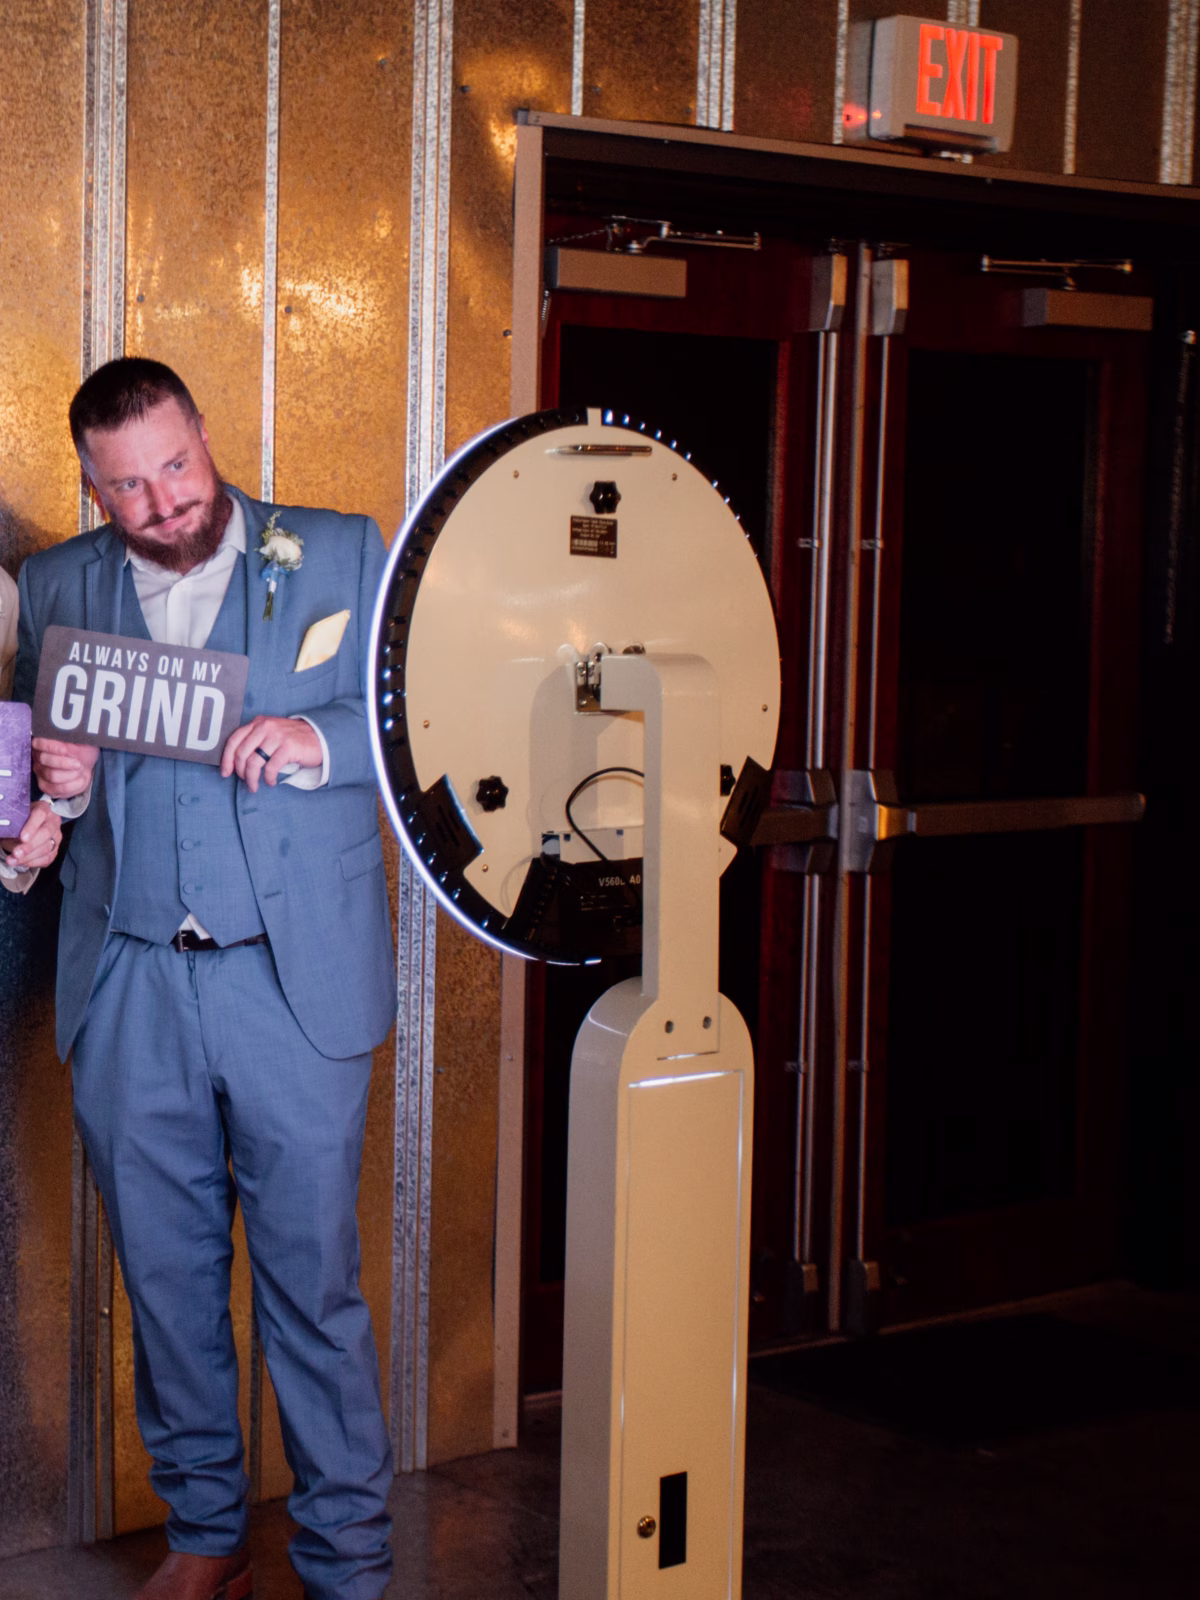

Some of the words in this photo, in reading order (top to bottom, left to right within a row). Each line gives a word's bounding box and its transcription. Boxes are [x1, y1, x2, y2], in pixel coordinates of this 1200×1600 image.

[915, 23, 1004, 125] EXIT
[68, 641, 150, 673] ALWAYS
[157, 654, 184, 678] ON
[191, 660, 222, 683] MY
[50, 664, 226, 752] GRIND
